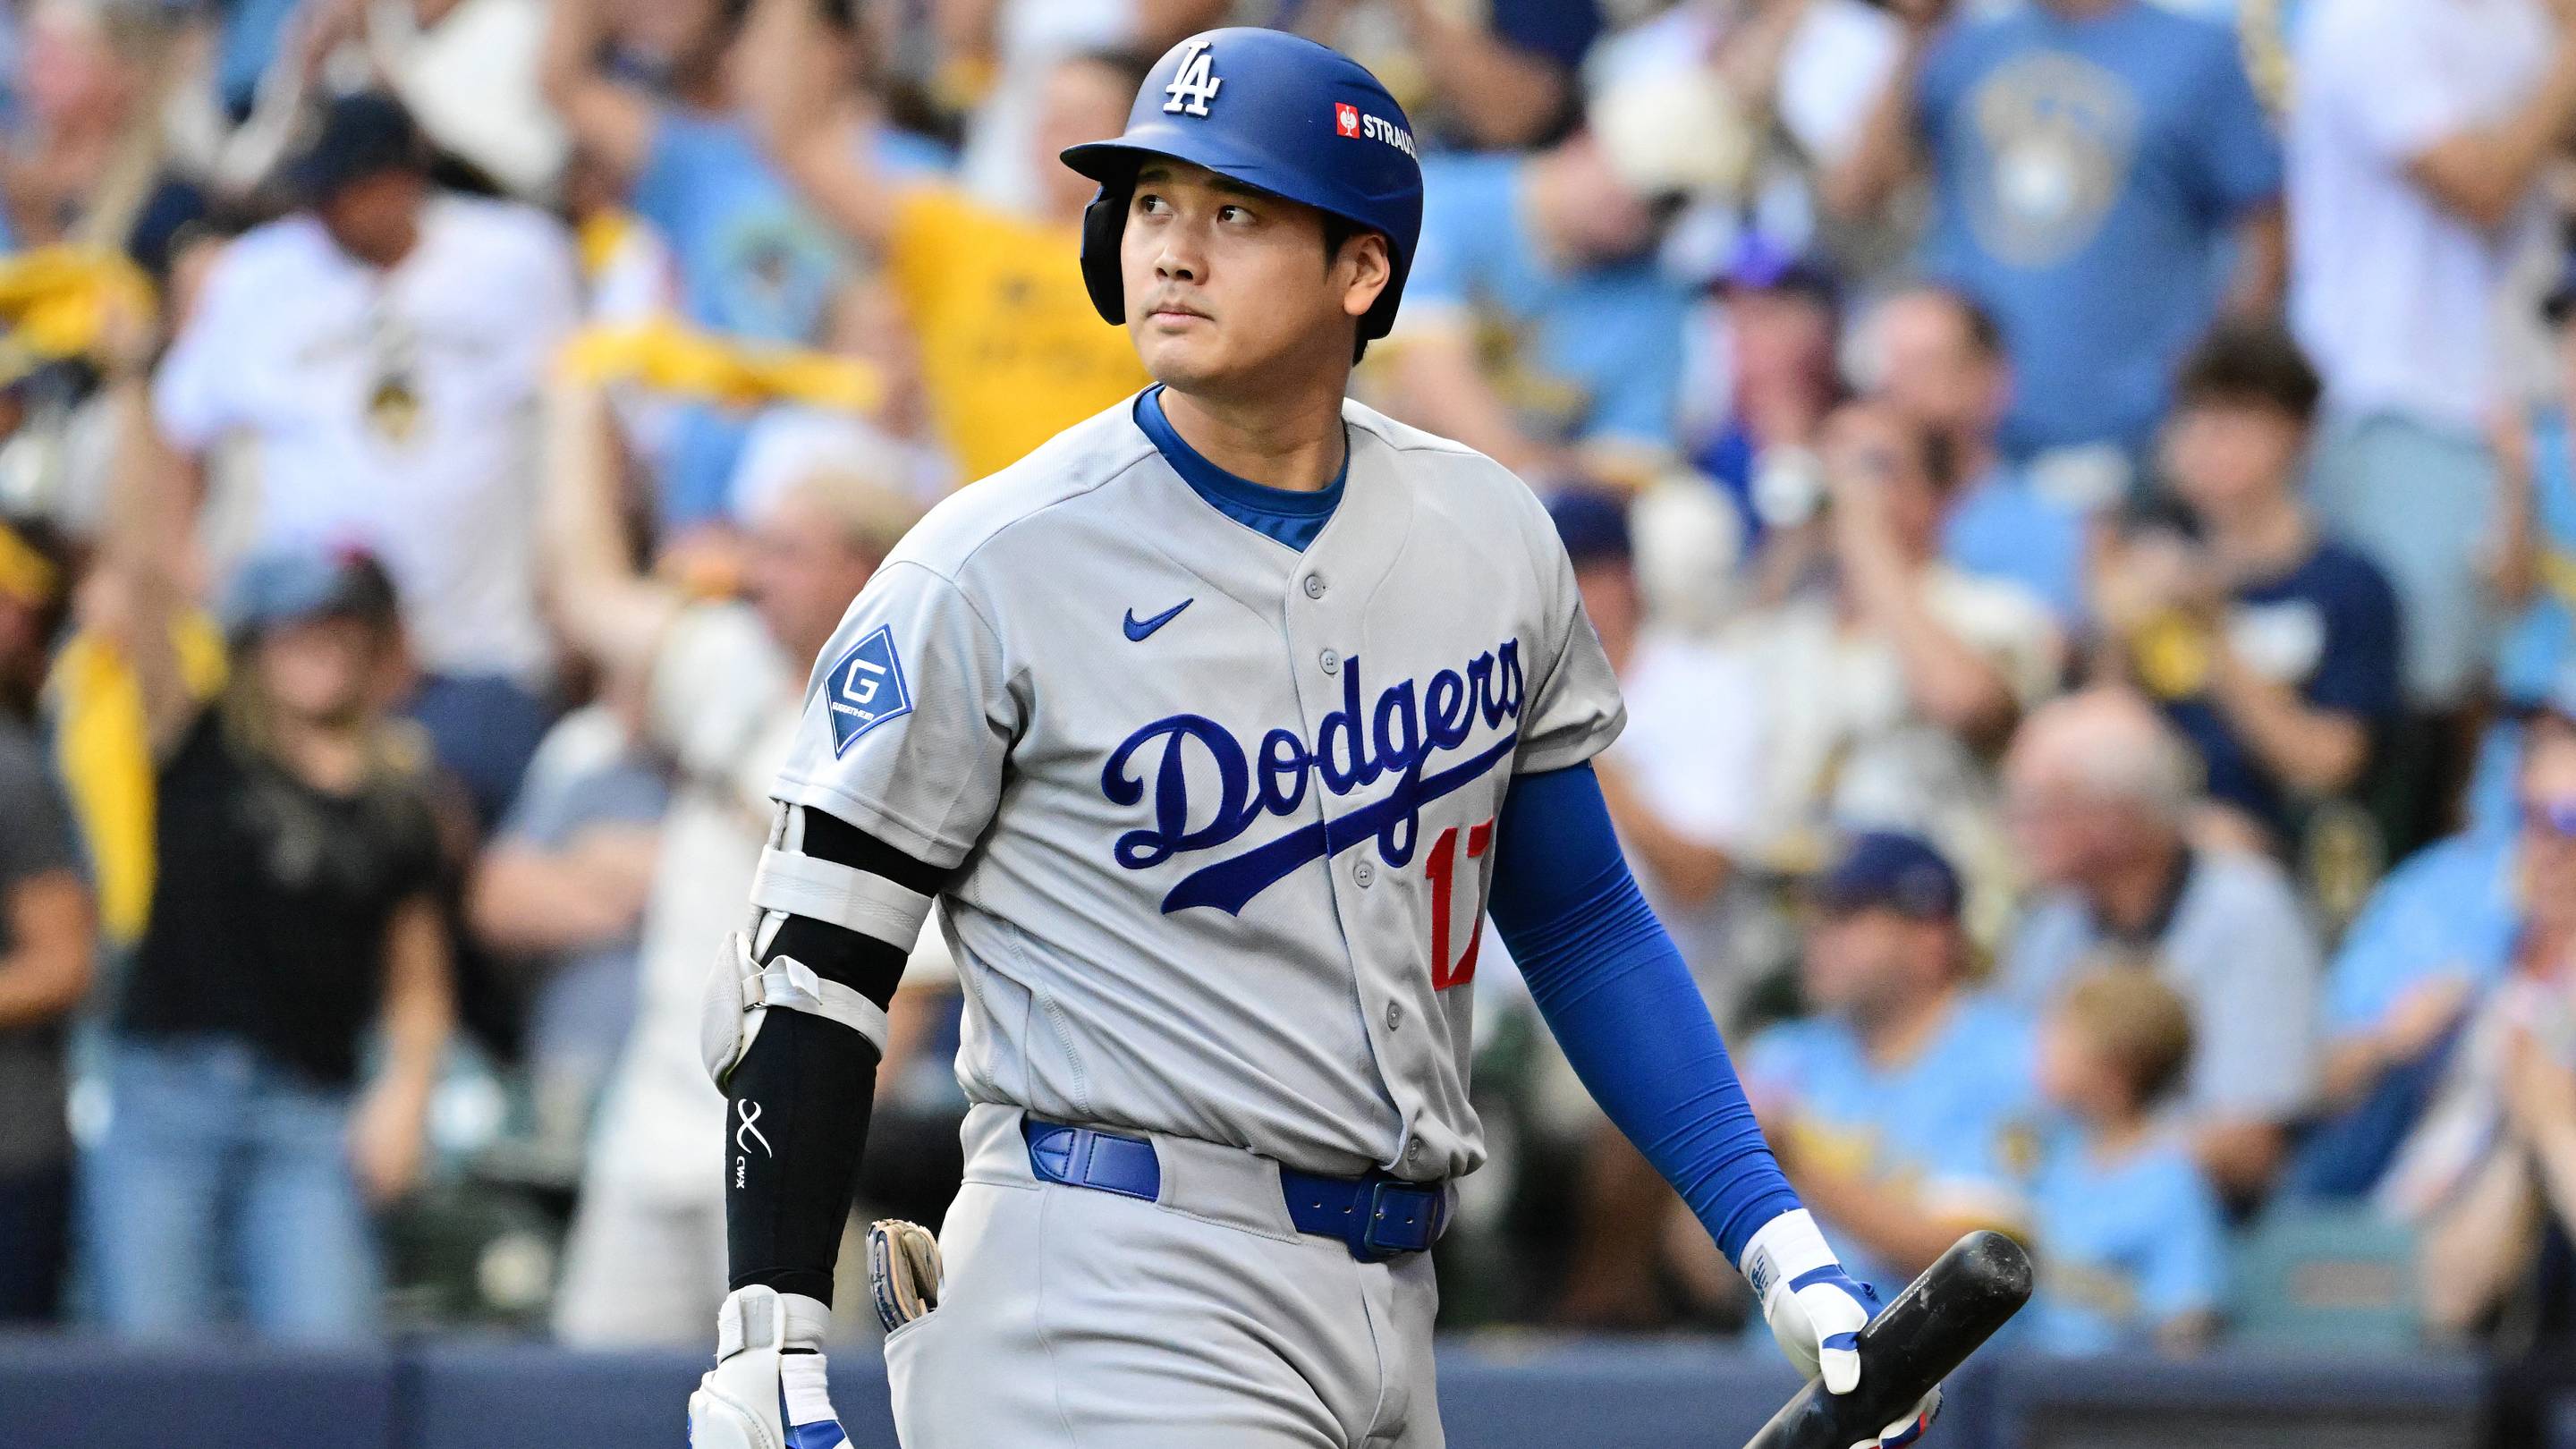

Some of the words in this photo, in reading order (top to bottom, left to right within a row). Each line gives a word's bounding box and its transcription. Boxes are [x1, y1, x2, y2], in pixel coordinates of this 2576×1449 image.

[1163, 40, 1222, 117] LA
[1362, 114, 1419, 163] STRAUS
[843, 658, 886, 704] G
[1101, 638, 1524, 871] Dodgers
